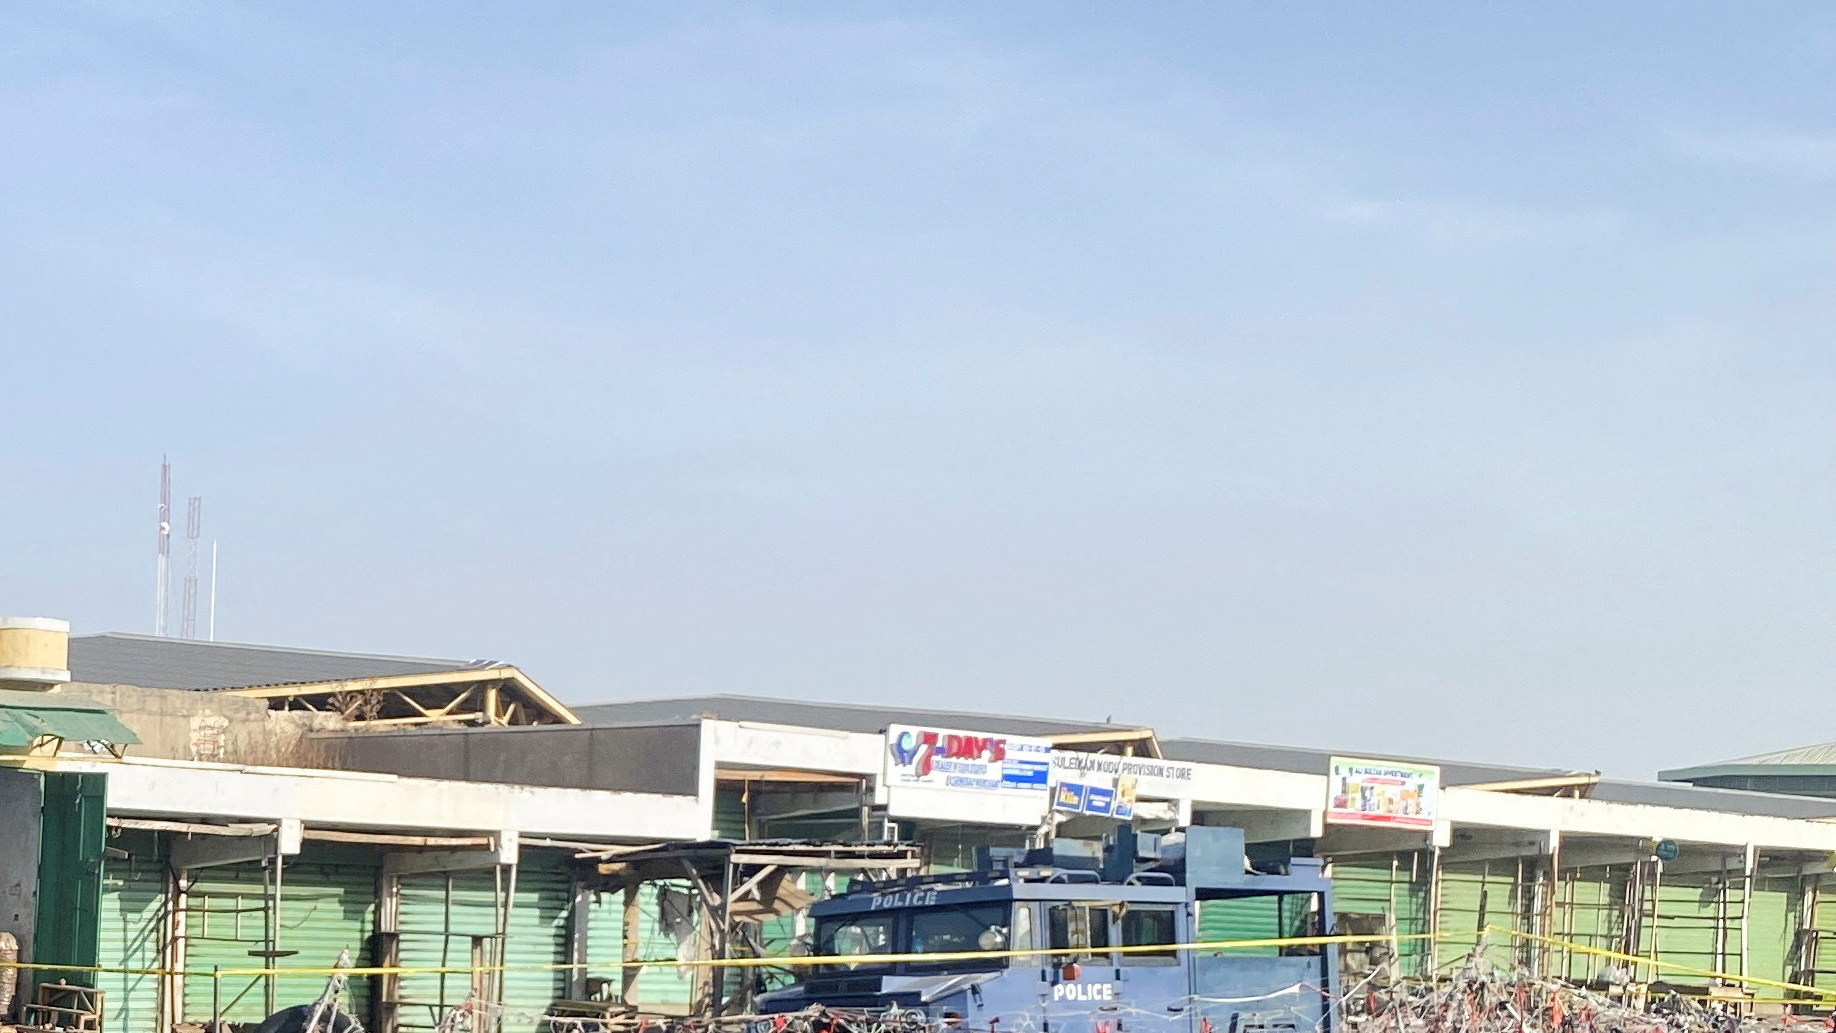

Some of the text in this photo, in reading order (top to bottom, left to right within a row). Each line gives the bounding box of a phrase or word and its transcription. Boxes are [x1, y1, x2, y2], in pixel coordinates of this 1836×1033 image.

[1121, 764, 1164, 778] PROVISION
[1165, 767, 1192, 781] STORE
[870, 890, 939, 910] POLICE
[1053, 983, 1113, 1001] POLICE
